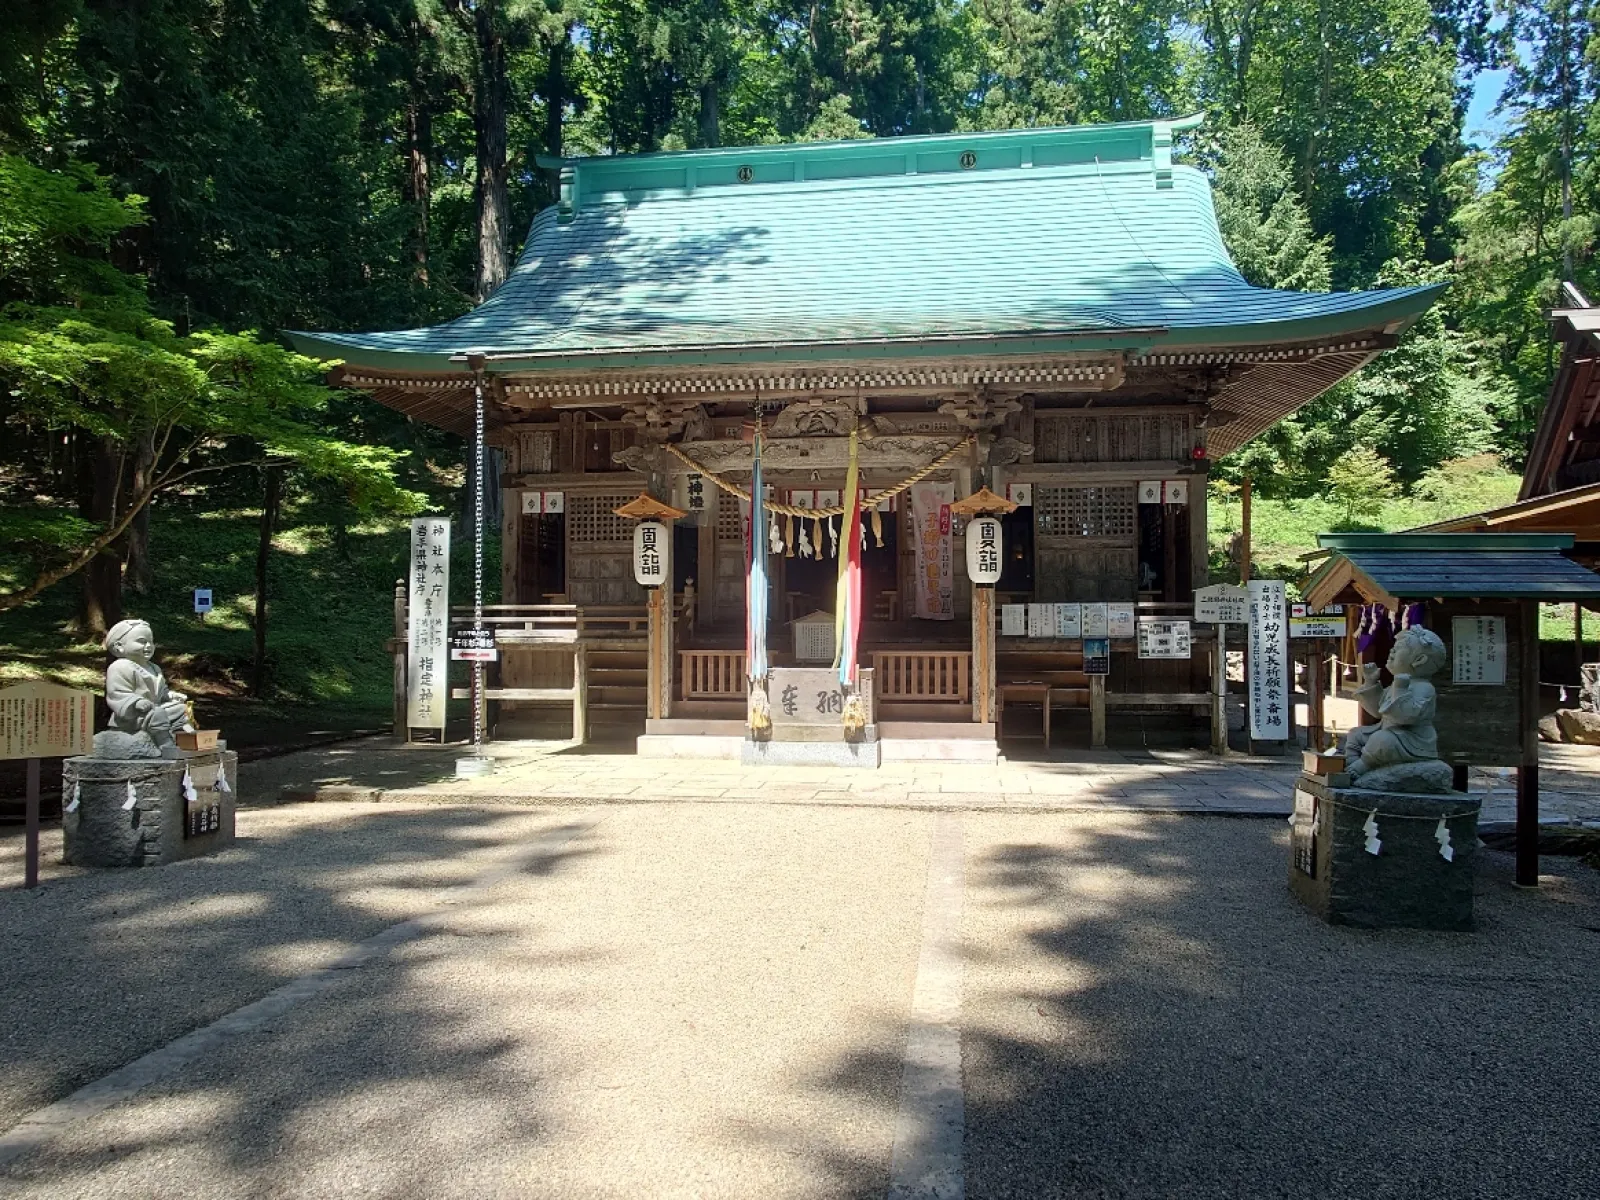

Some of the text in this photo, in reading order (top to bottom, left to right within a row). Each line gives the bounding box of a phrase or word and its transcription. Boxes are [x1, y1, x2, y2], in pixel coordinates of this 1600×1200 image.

[414, 524, 428, 597] 岩手県神社庁
[430, 524, 445, 598] 神社本庁
[418, 656, 434, 719] 指定神社
[781, 684, 844, 716] 奉納
